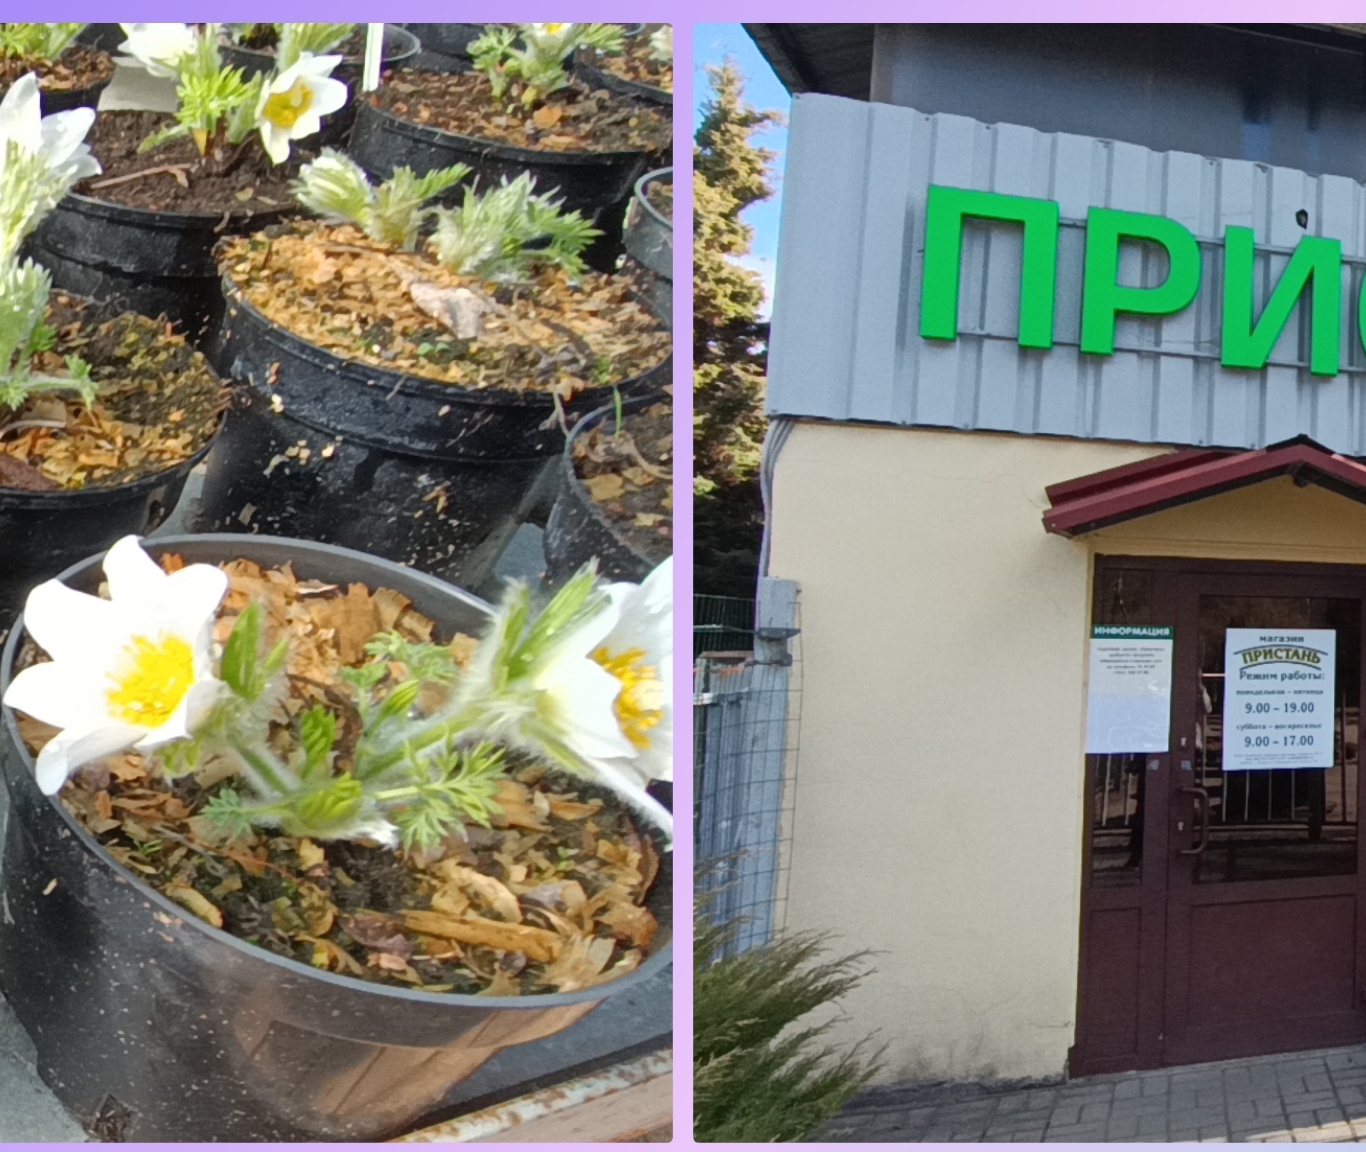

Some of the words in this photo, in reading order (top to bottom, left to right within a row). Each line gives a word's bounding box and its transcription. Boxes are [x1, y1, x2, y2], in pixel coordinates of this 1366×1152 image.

[1094, 626, 1170, 637] ИНФОРМАЦИЯ
[1241, 648, 1321, 665] ПРИСТАНЬ
[1239, 671, 1277, 680] Режим
[1280, 670, 1325, 682] работы:
[1245, 702, 1270, 714] 9.00
[1284, 702, 1314, 713] 19.00
[1244, 736, 1270, 748] 9.00
[1283, 735, 1314, 747] 17.00
